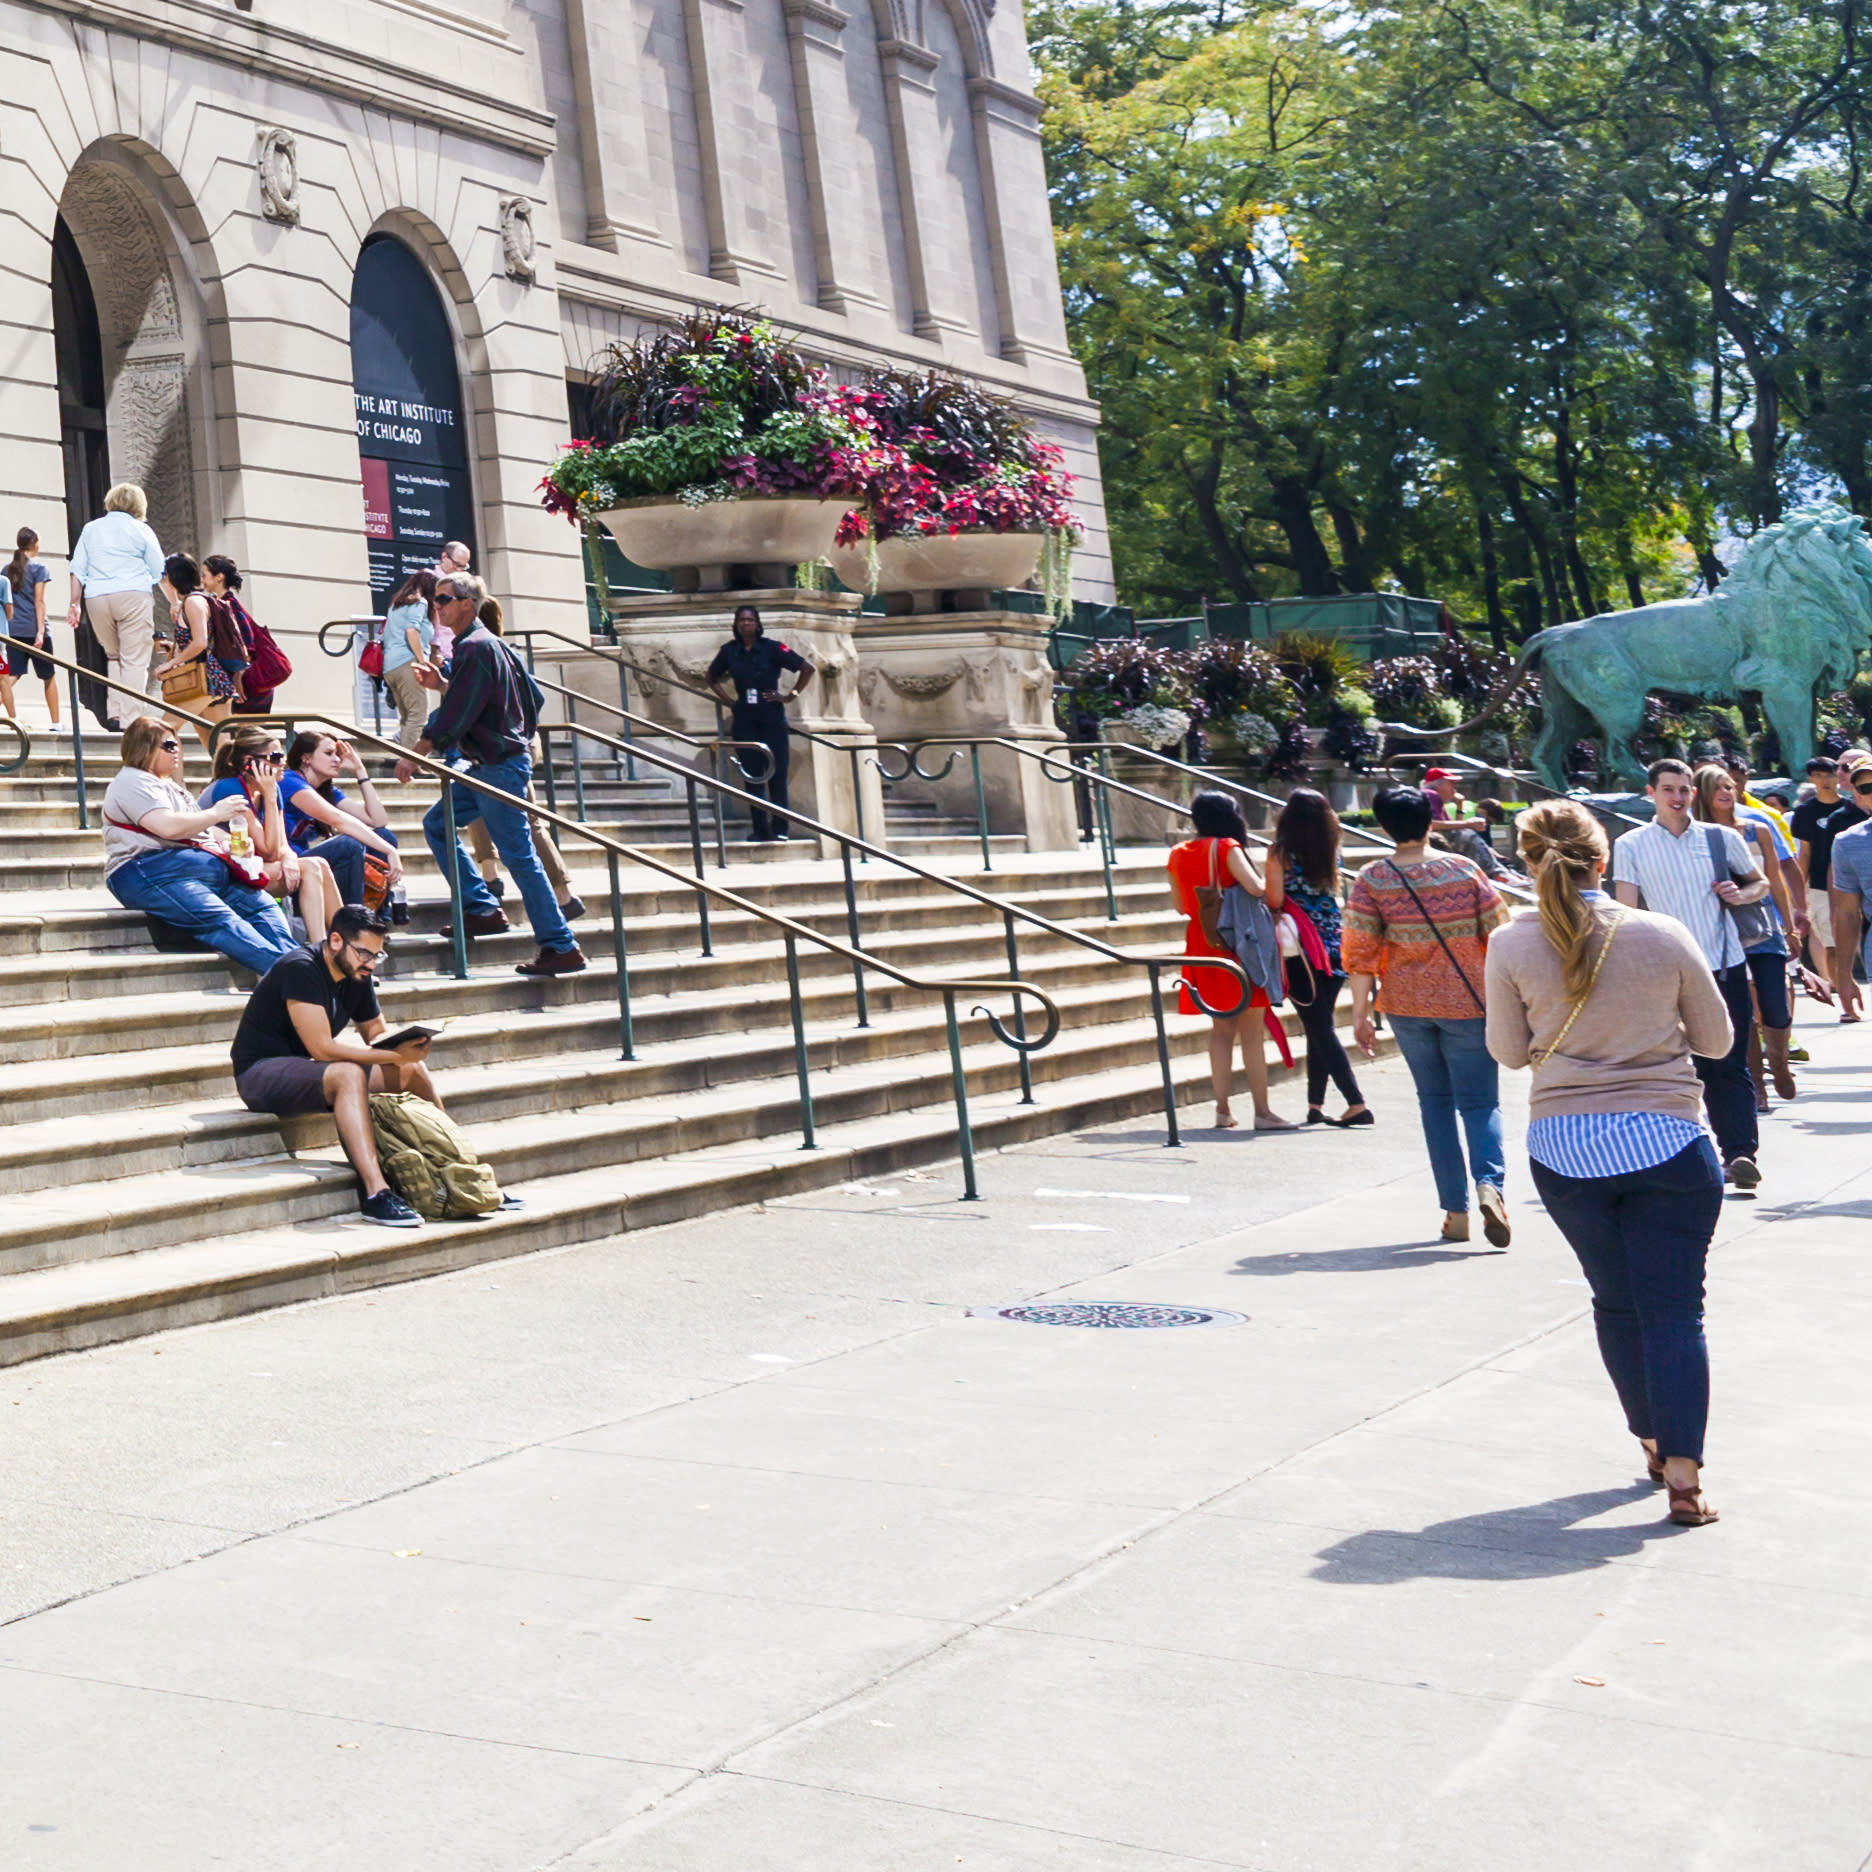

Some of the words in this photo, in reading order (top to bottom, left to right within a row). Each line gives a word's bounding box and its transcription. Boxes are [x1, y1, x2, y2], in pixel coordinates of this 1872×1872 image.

[354, 393, 376, 412] THE
[378, 398, 398, 417] ART
[400, 401, 455, 426] INSTITUTE
[356, 419, 371, 437] OF
[373, 422, 422, 445] CHICAGO
